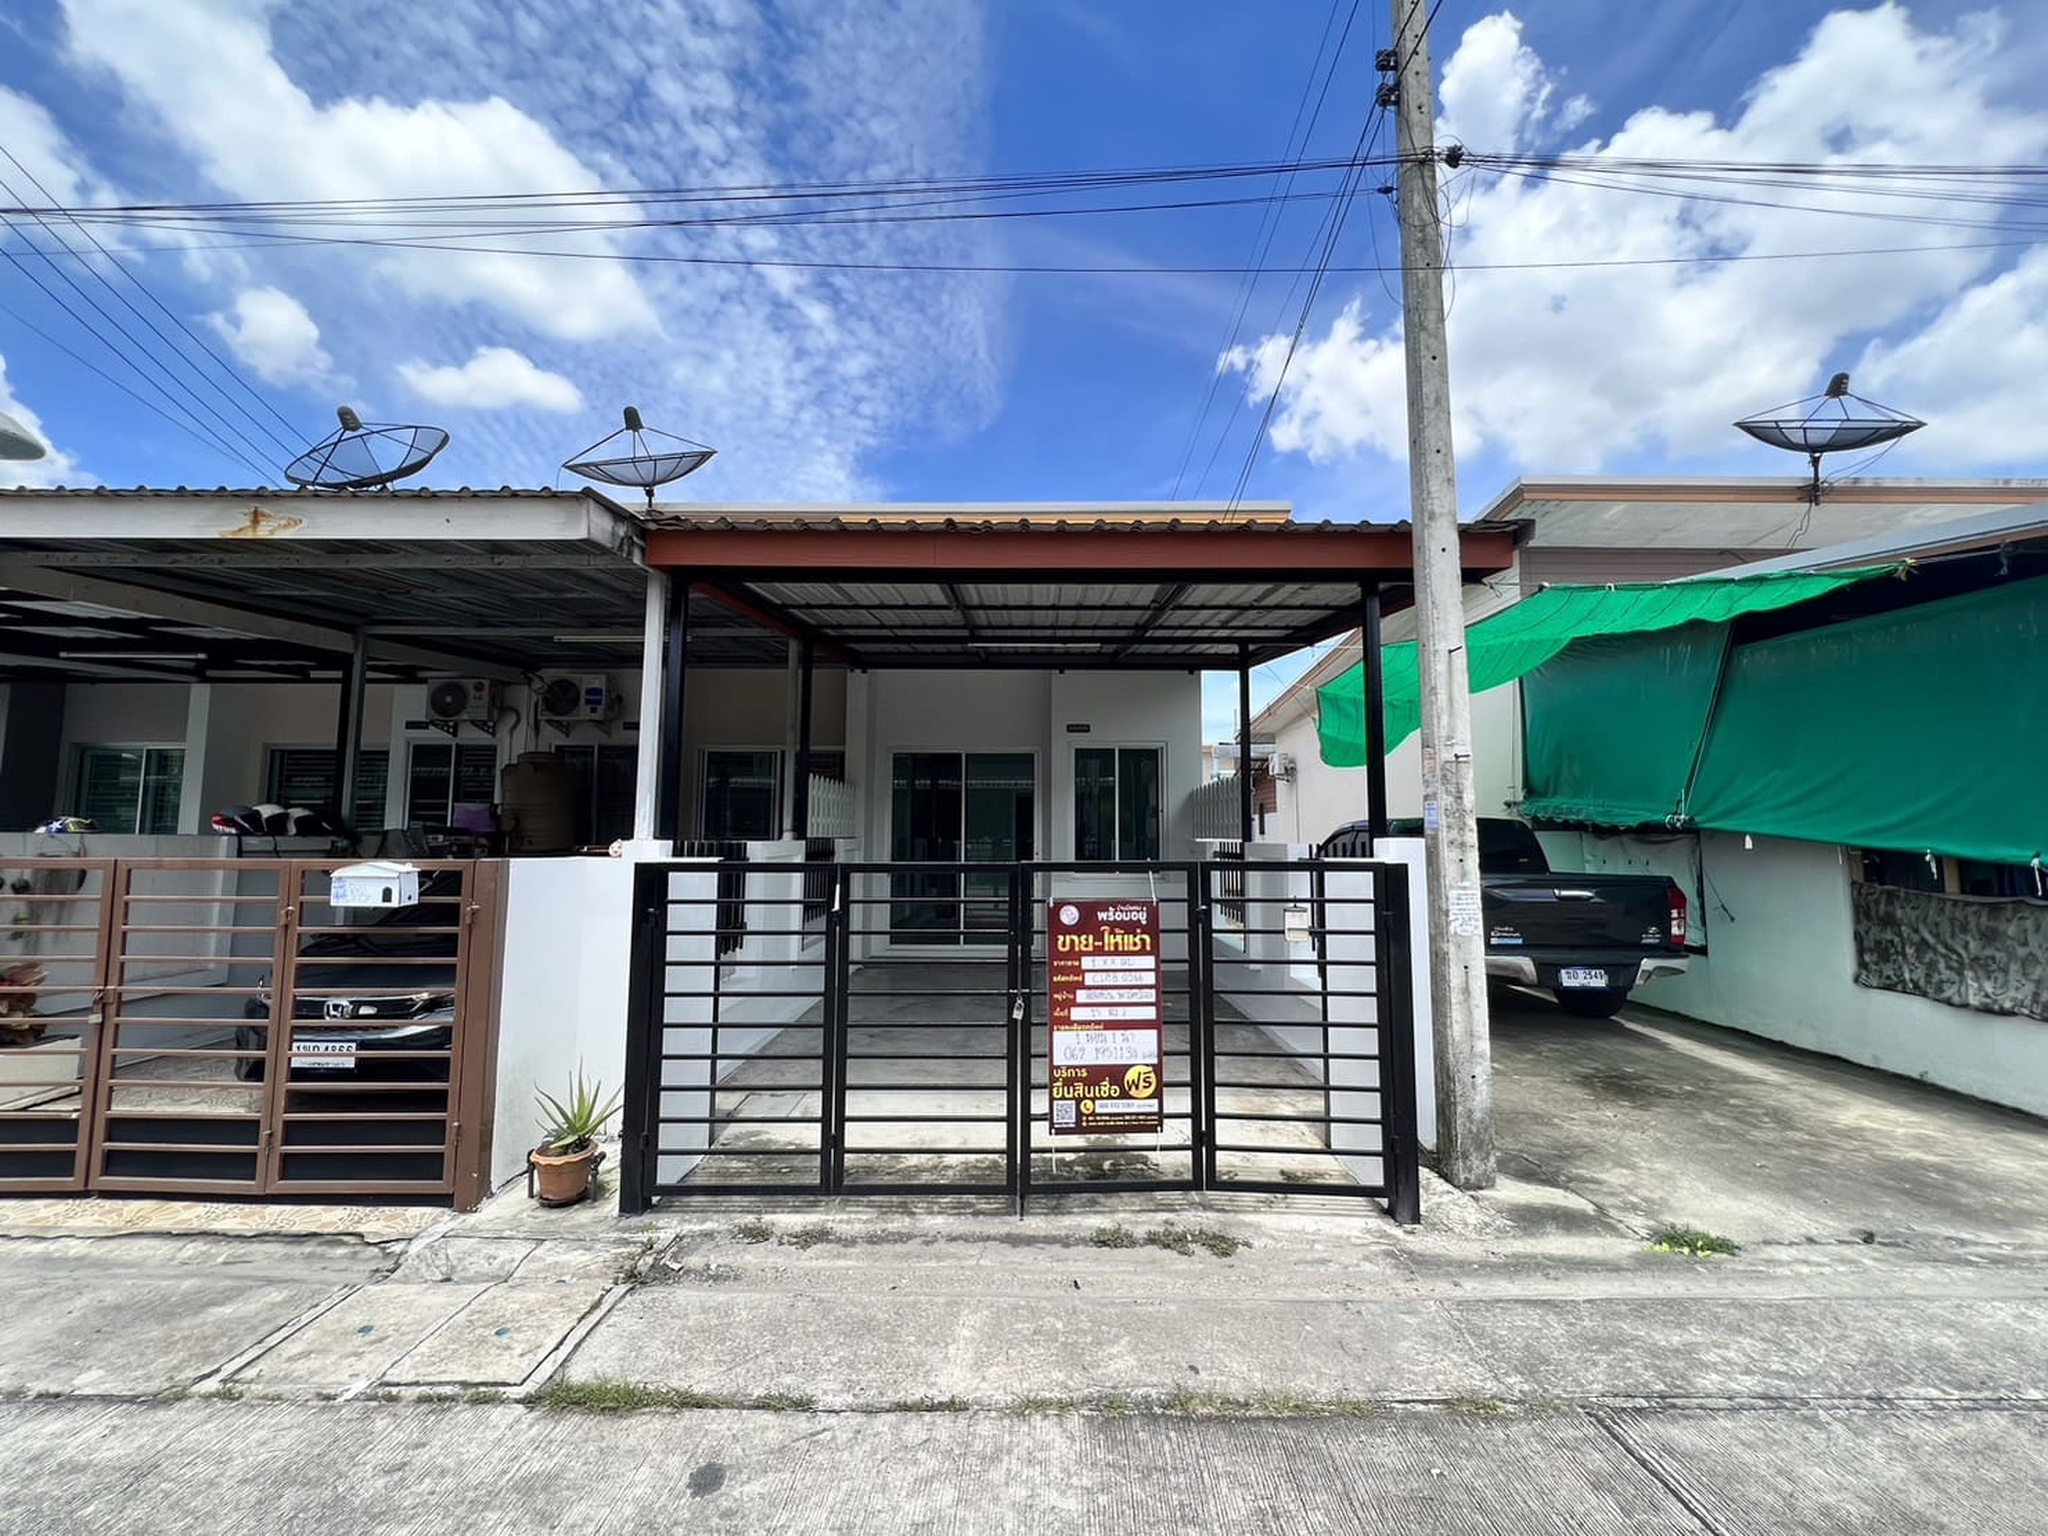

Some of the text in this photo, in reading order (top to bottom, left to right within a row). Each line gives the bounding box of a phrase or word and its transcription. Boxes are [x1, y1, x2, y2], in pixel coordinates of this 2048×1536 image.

[1097, 906, 1148, 925] พร้อมอยู่
[1057, 925, 1151, 952] ขาย-ให้เช่า
[1053, 1066, 1088, 1078] บริการ
[1126, 1069, 1153, 1092] ฟรี
[1052, 1077, 1120, 1098] ยื่นสินเชื่อ
